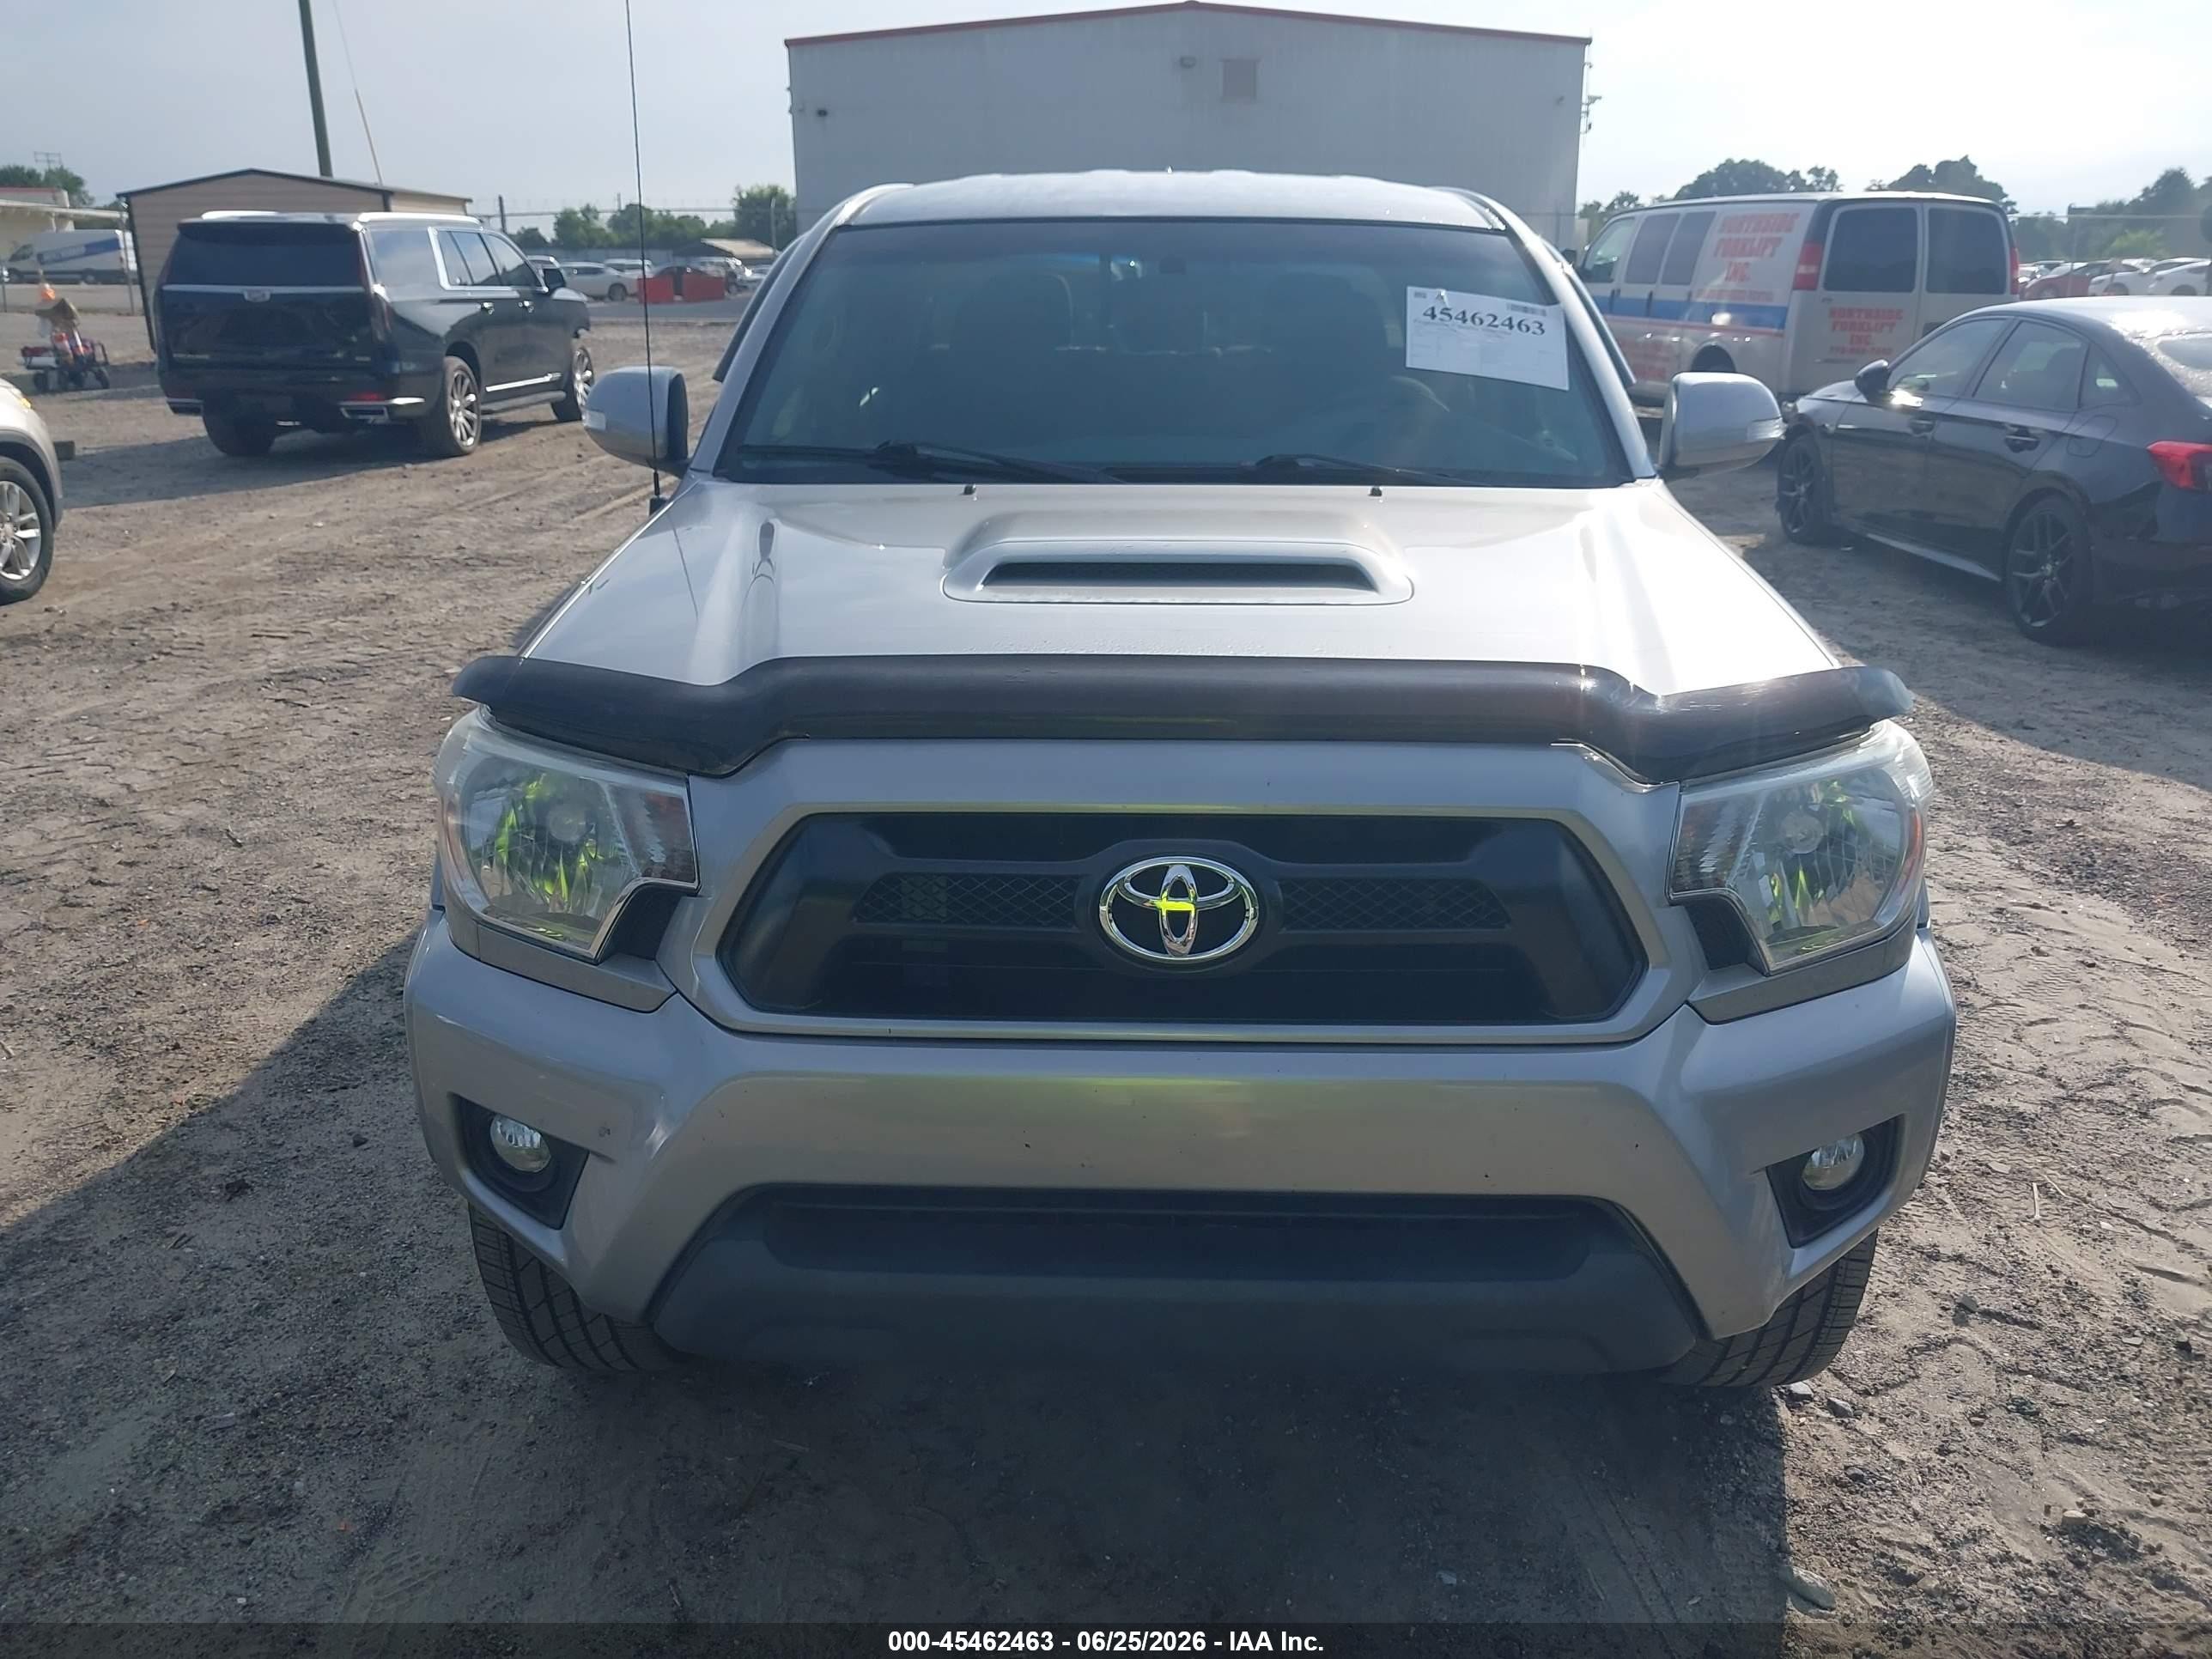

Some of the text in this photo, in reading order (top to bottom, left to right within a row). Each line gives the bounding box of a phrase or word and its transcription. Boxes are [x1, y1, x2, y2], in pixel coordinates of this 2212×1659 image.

[1713, 236, 1784, 258] FORKLIFT
[1422, 306, 1546, 336] 45462463
[1829, 307, 1904, 320] NORTHSIDE
[1832, 320, 1896, 333] FORKLIFT
